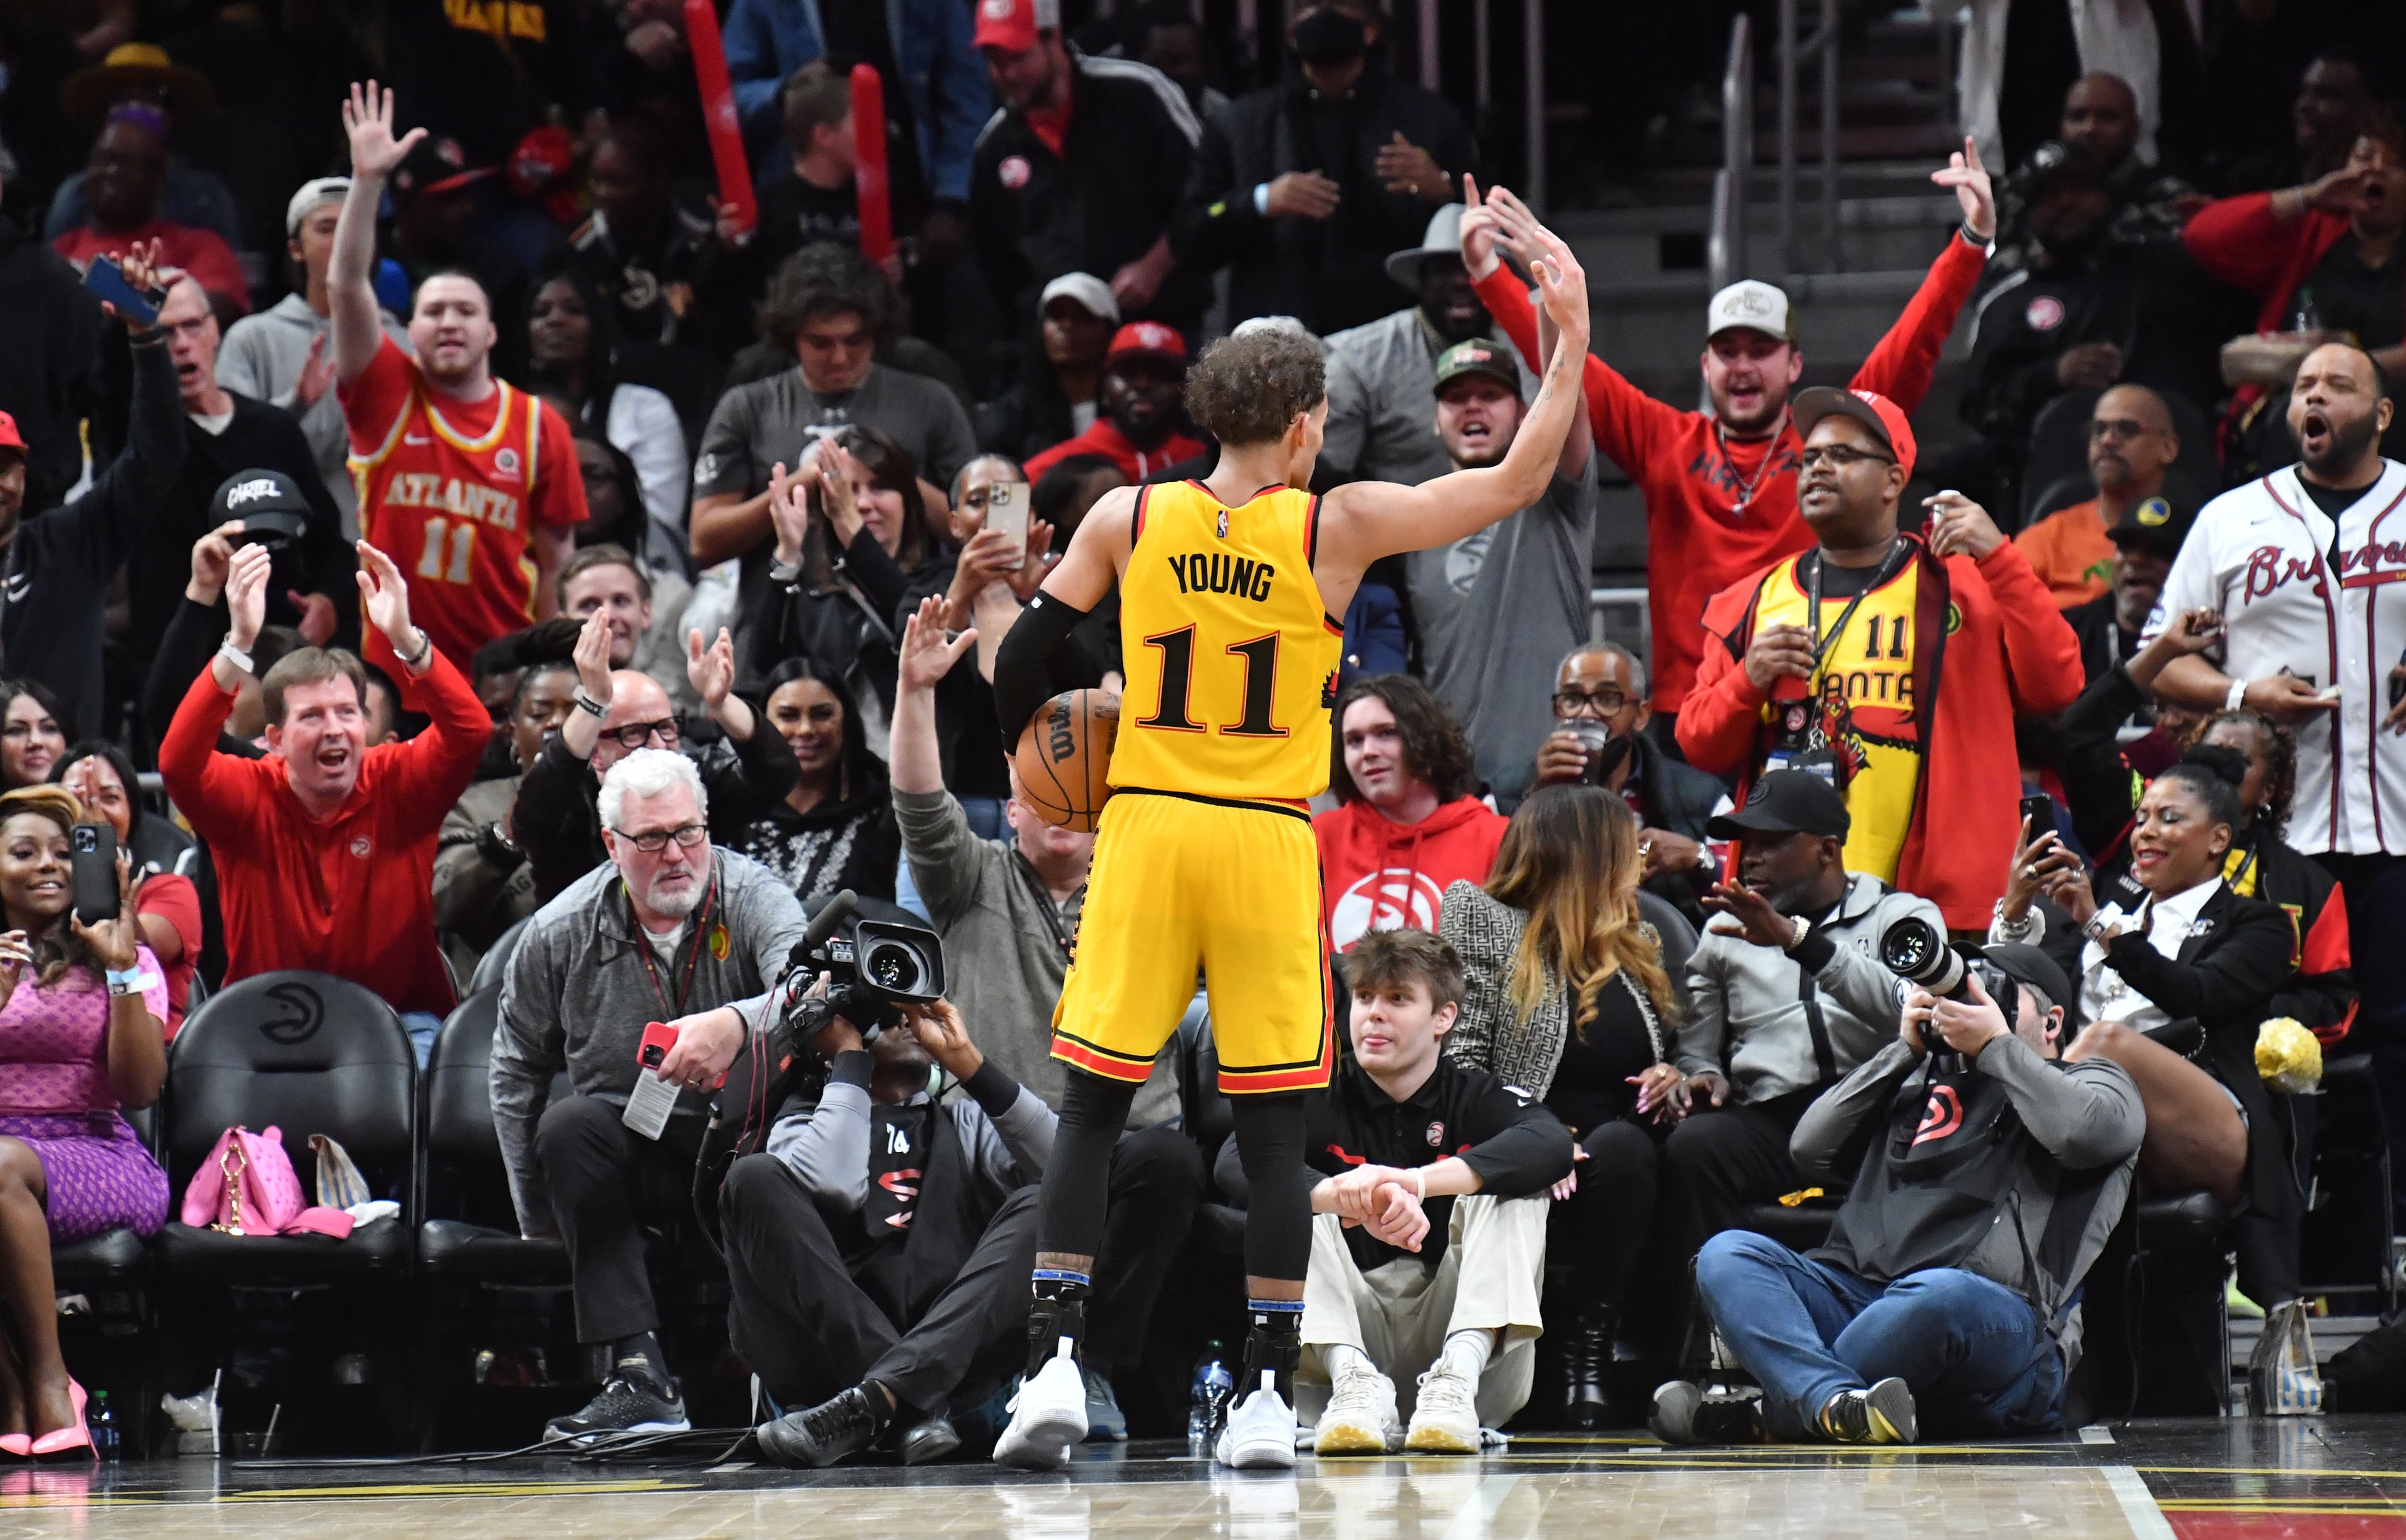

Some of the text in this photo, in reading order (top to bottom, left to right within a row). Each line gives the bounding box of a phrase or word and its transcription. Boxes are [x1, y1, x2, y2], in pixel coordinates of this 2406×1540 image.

[384, 473, 518, 532] ATLANTA
[417, 517, 474, 584] 11
[1168, 553, 1275, 602] YOUNG
[1865, 613, 1909, 662] 11
[1135, 622, 1289, 738] 11
